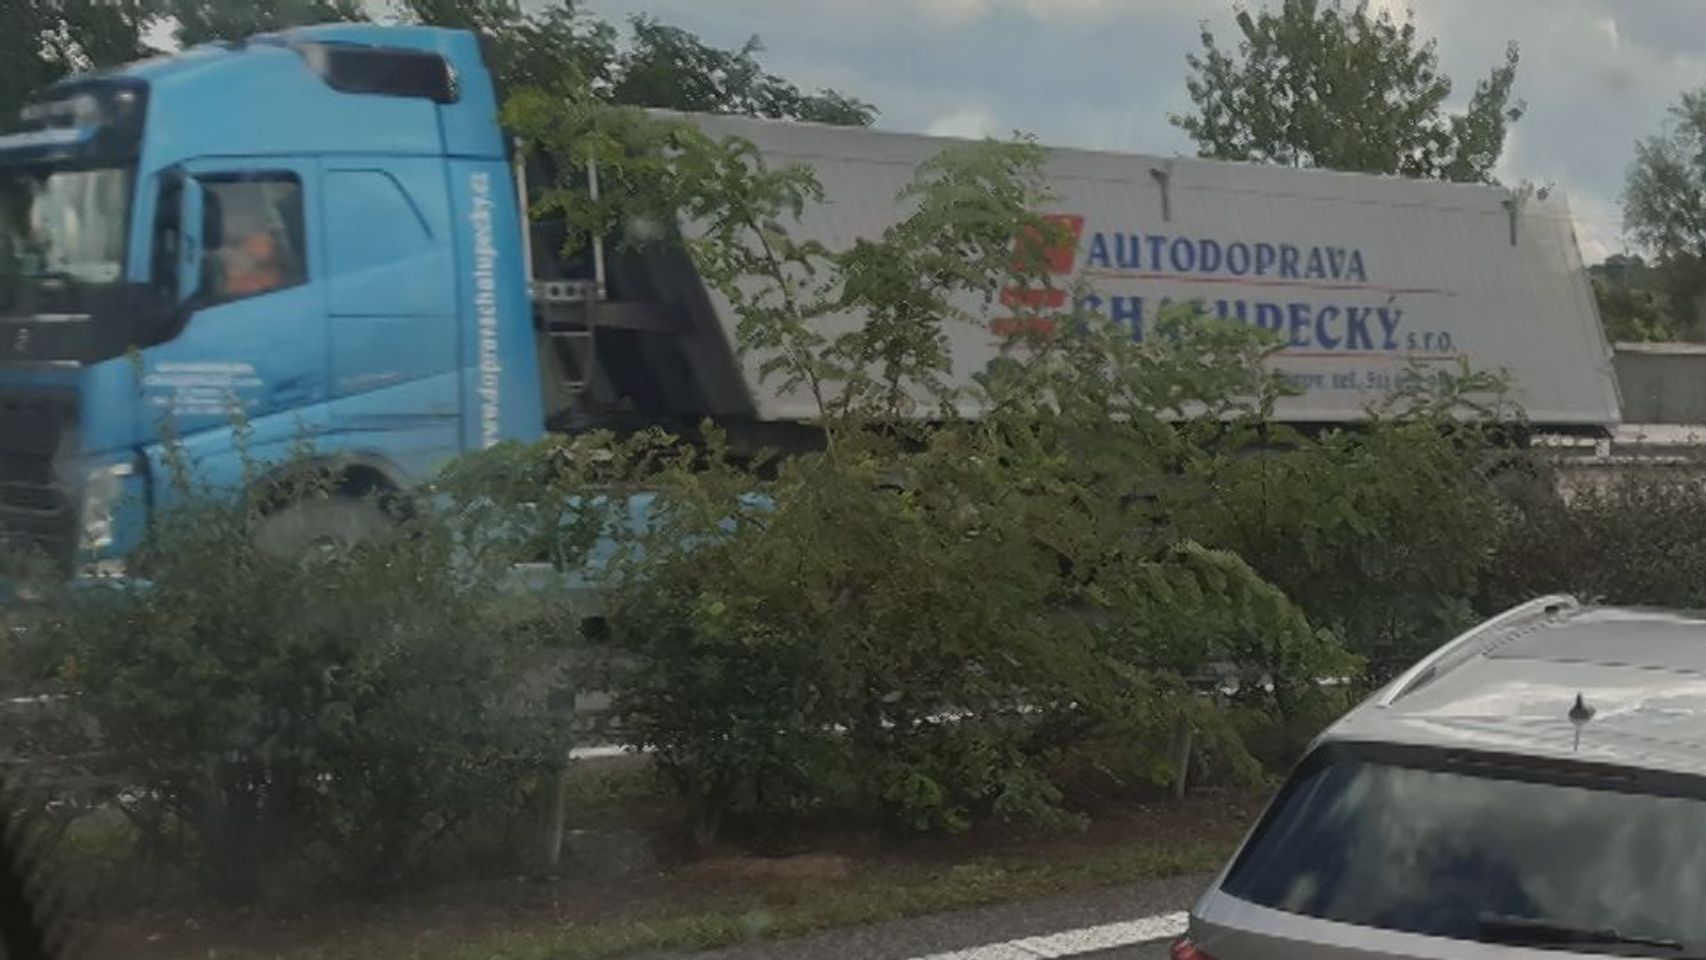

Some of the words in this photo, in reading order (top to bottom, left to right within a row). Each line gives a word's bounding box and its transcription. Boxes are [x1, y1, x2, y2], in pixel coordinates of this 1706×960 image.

[1086, 232, 1368, 282] AUTODOPRAVA
[1075, 295, 1404, 350] CHPECKÝ
[1406, 331, 1458, 353] s.r.o.
